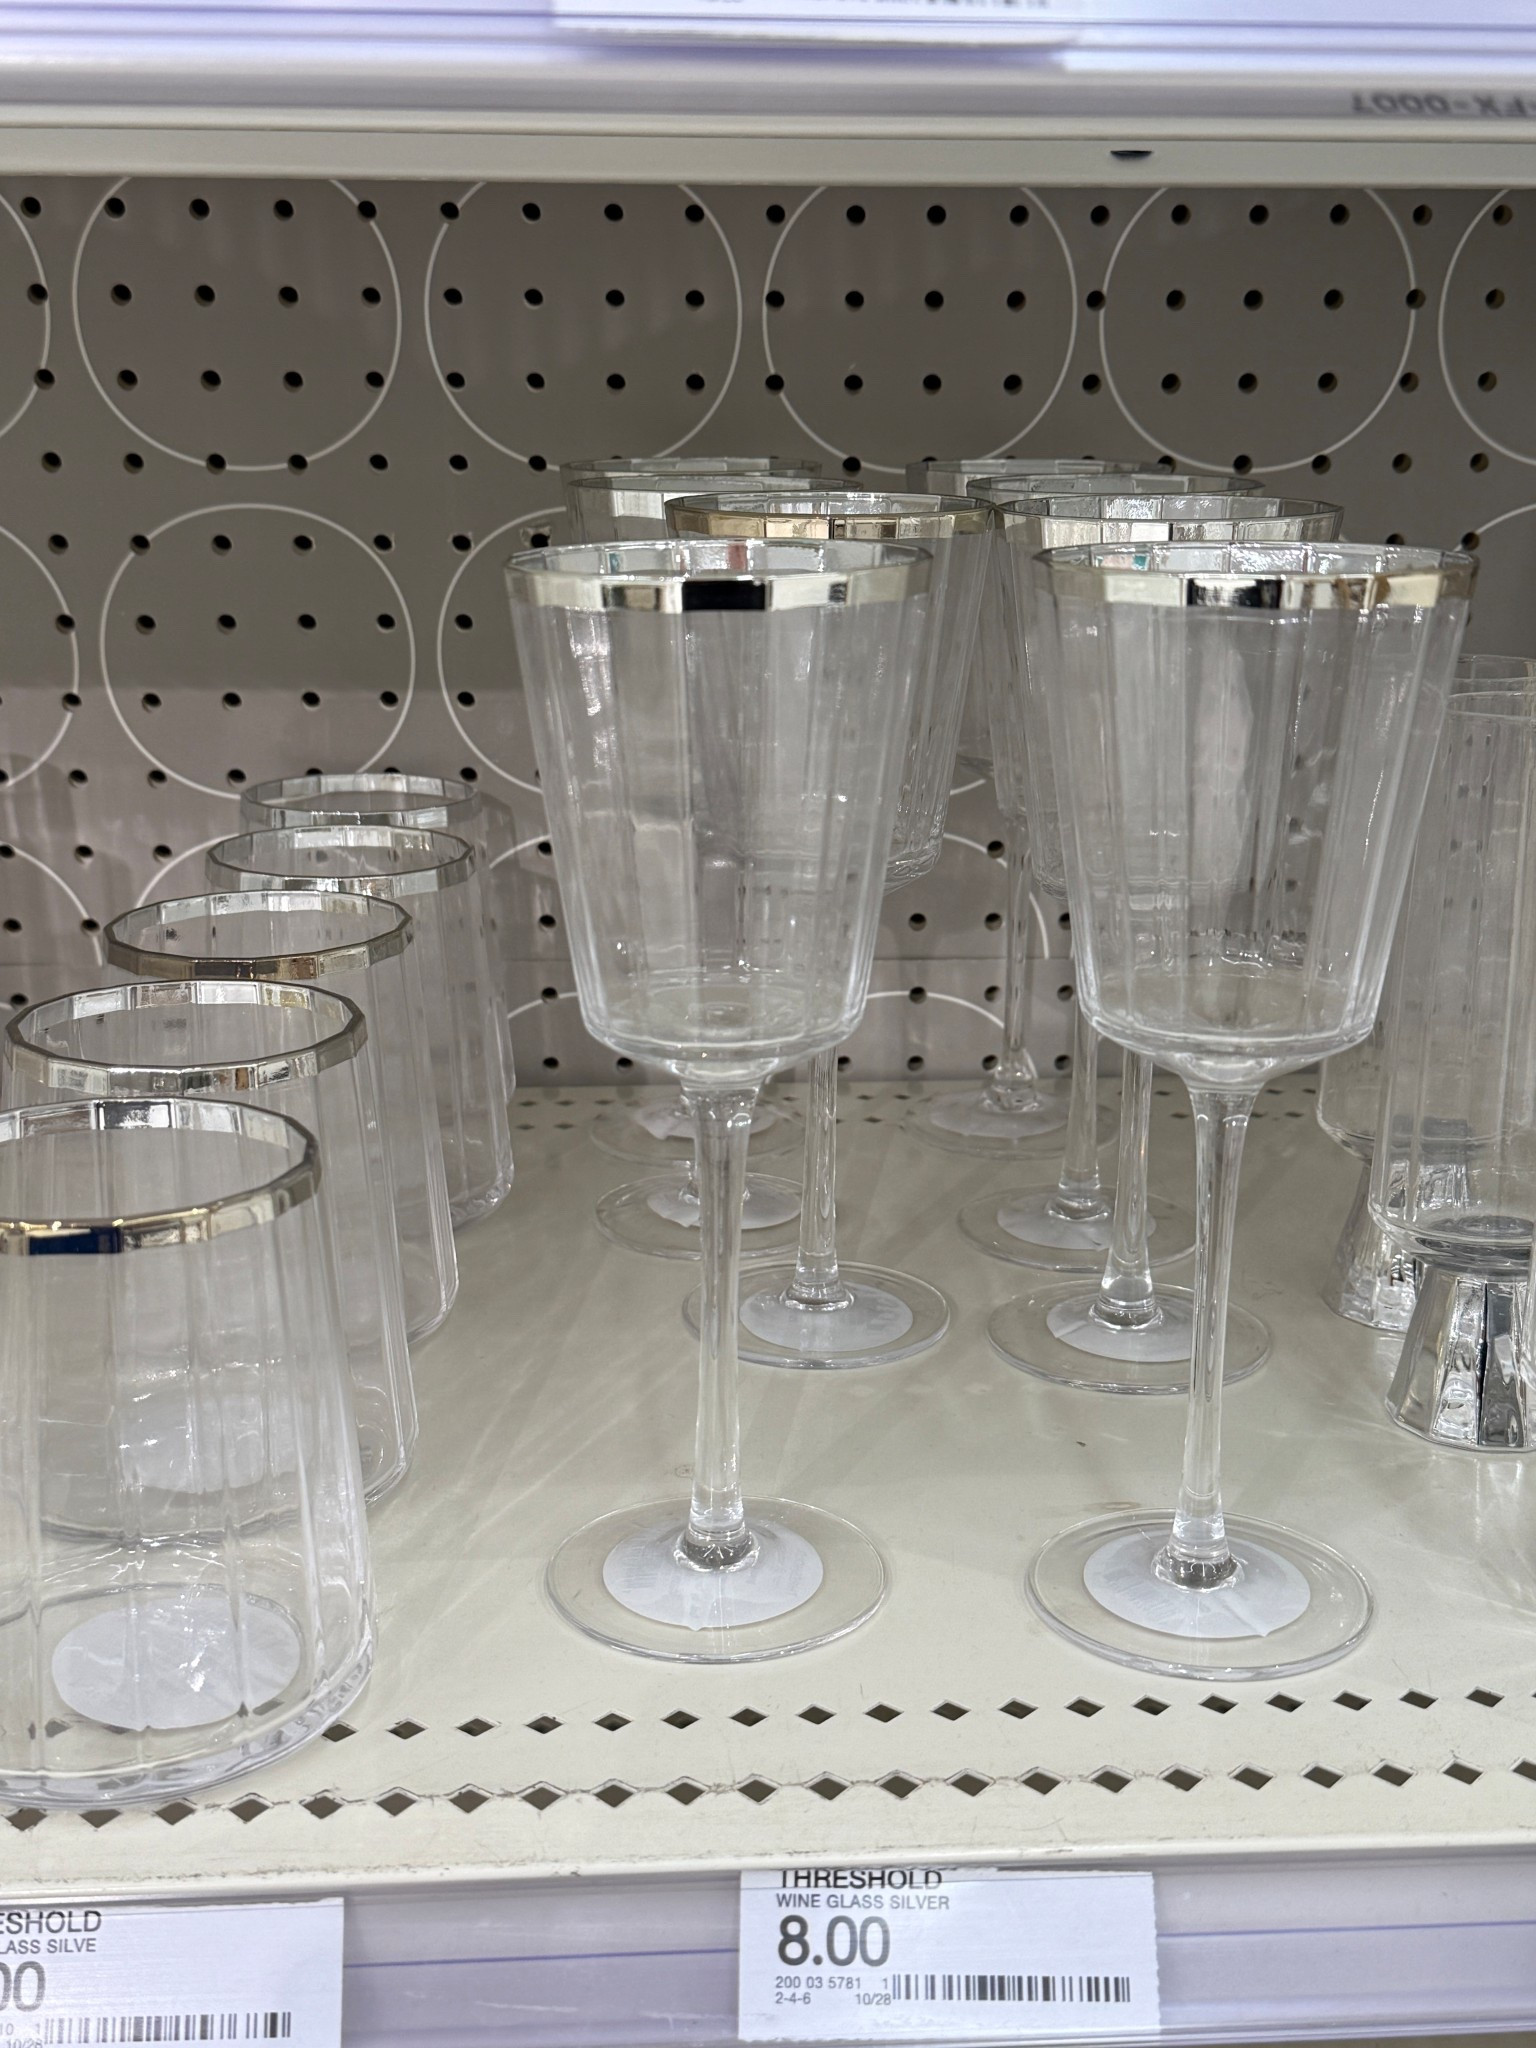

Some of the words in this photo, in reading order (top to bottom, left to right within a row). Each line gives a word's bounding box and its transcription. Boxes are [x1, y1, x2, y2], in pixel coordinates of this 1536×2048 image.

[781, 1869, 943, 1890] THRESHOLD
[776, 1893, 821, 1908] WINE
[827, 1894, 884, 1909] GLASS
[890, 1895, 950, 1910] SILVER
[47, 1938, 97, 1953] SILVE
[777, 1914, 891, 1968] 8.00
[775, 1976, 801, 1989] 200
[806, 1976, 823, 1989] 03
[827, 1976, 861, 1989] 5781
[882, 1977, 888, 1989] 1
[775, 1992, 811, 2005] 2-4-6
[855, 1993, 892, 2006] 10/28
